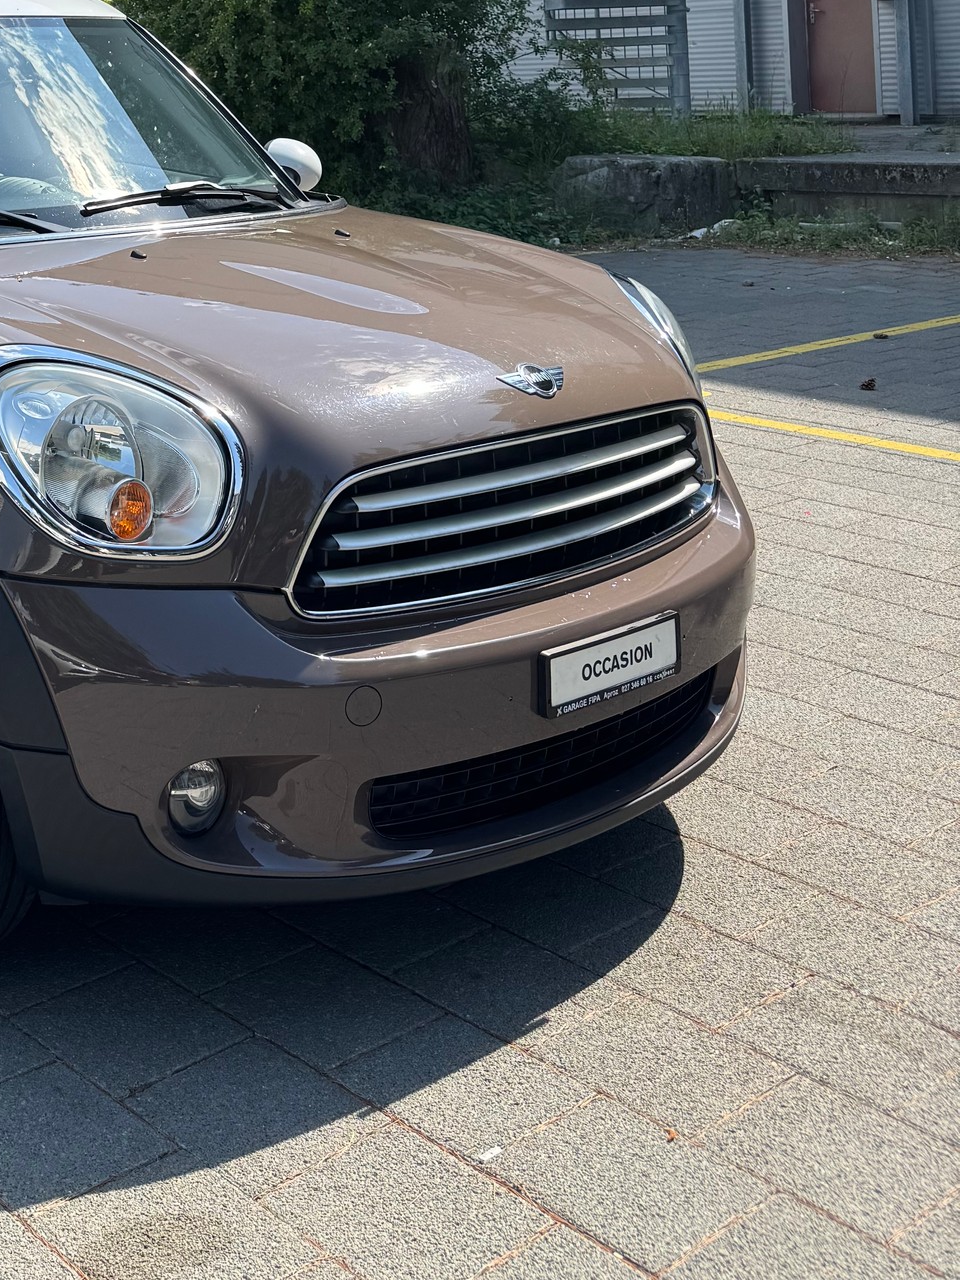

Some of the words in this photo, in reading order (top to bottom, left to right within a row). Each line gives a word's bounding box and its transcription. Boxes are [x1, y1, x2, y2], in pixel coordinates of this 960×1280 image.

[581, 641, 653, 681] OCCASION
[563, 698, 587, 714] GARAGE
[588, 695, 601, 705] FIPA
